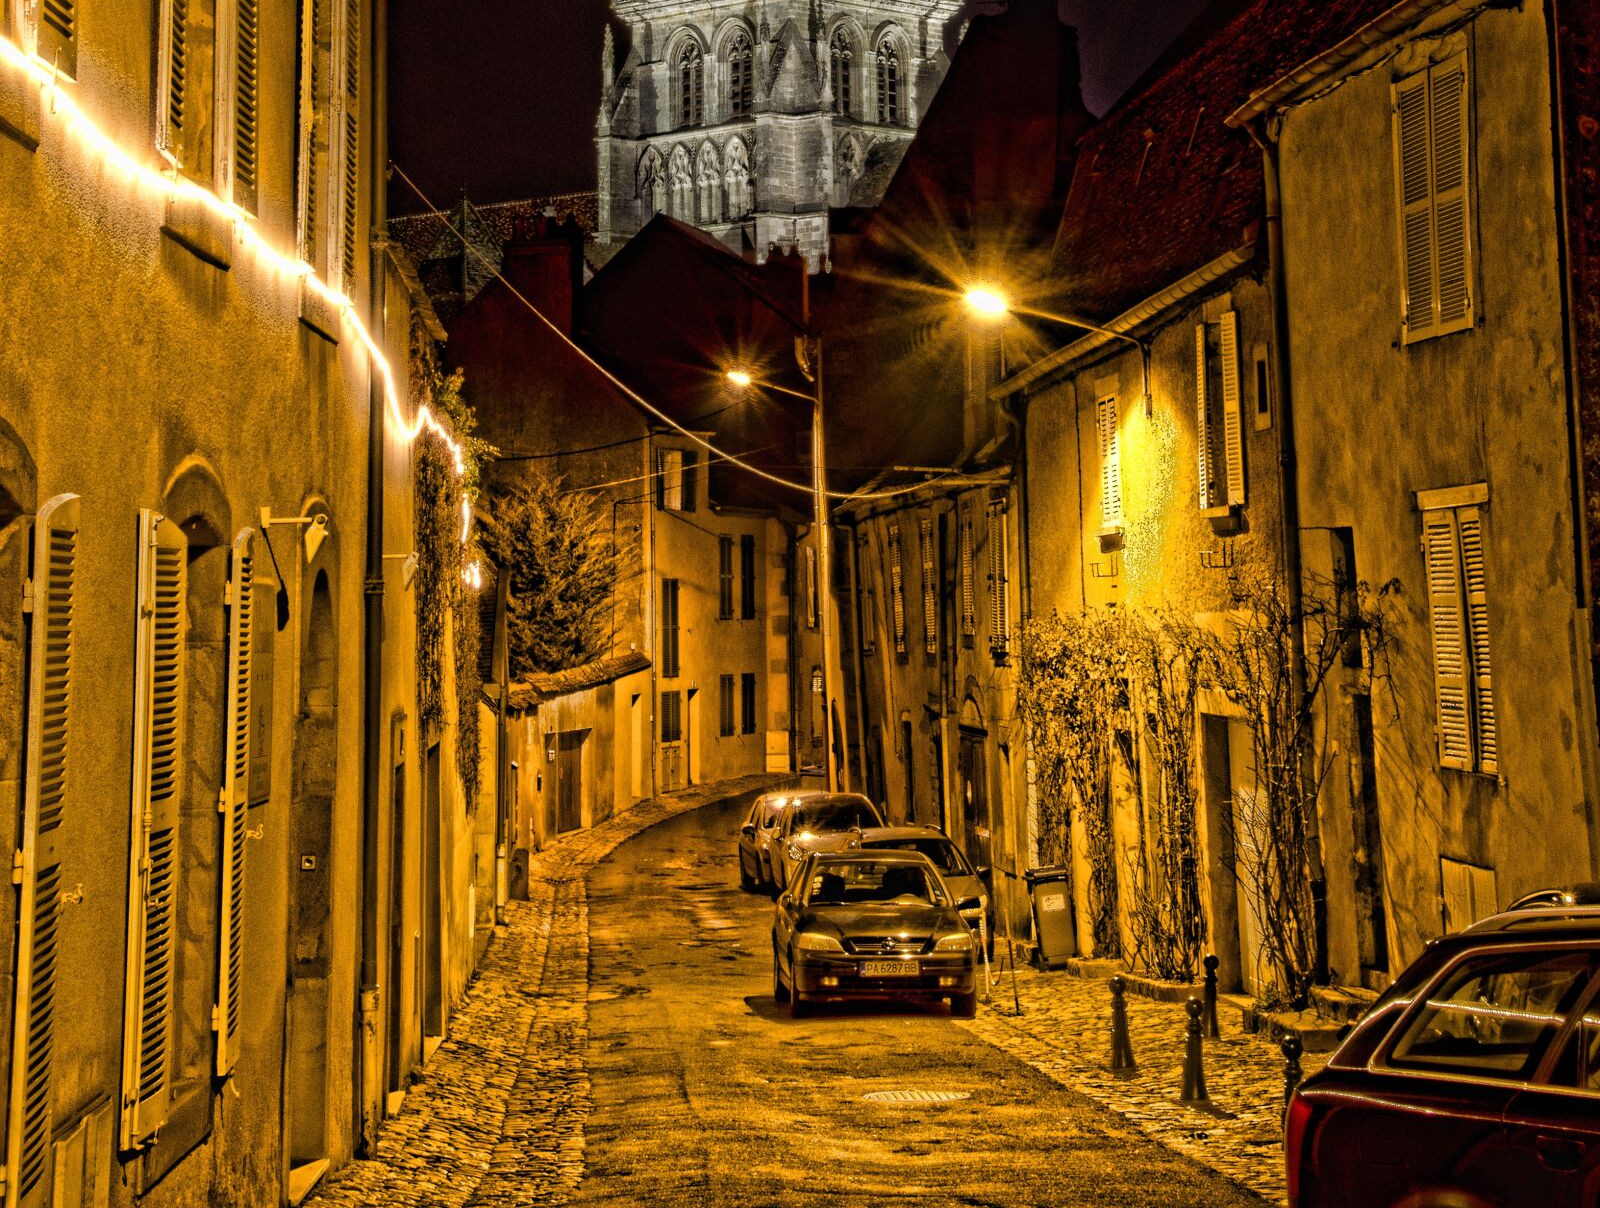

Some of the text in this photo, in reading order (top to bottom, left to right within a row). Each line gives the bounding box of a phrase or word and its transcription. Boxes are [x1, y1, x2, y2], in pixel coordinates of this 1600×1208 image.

[866, 963, 917, 974] PA 6287 BB
